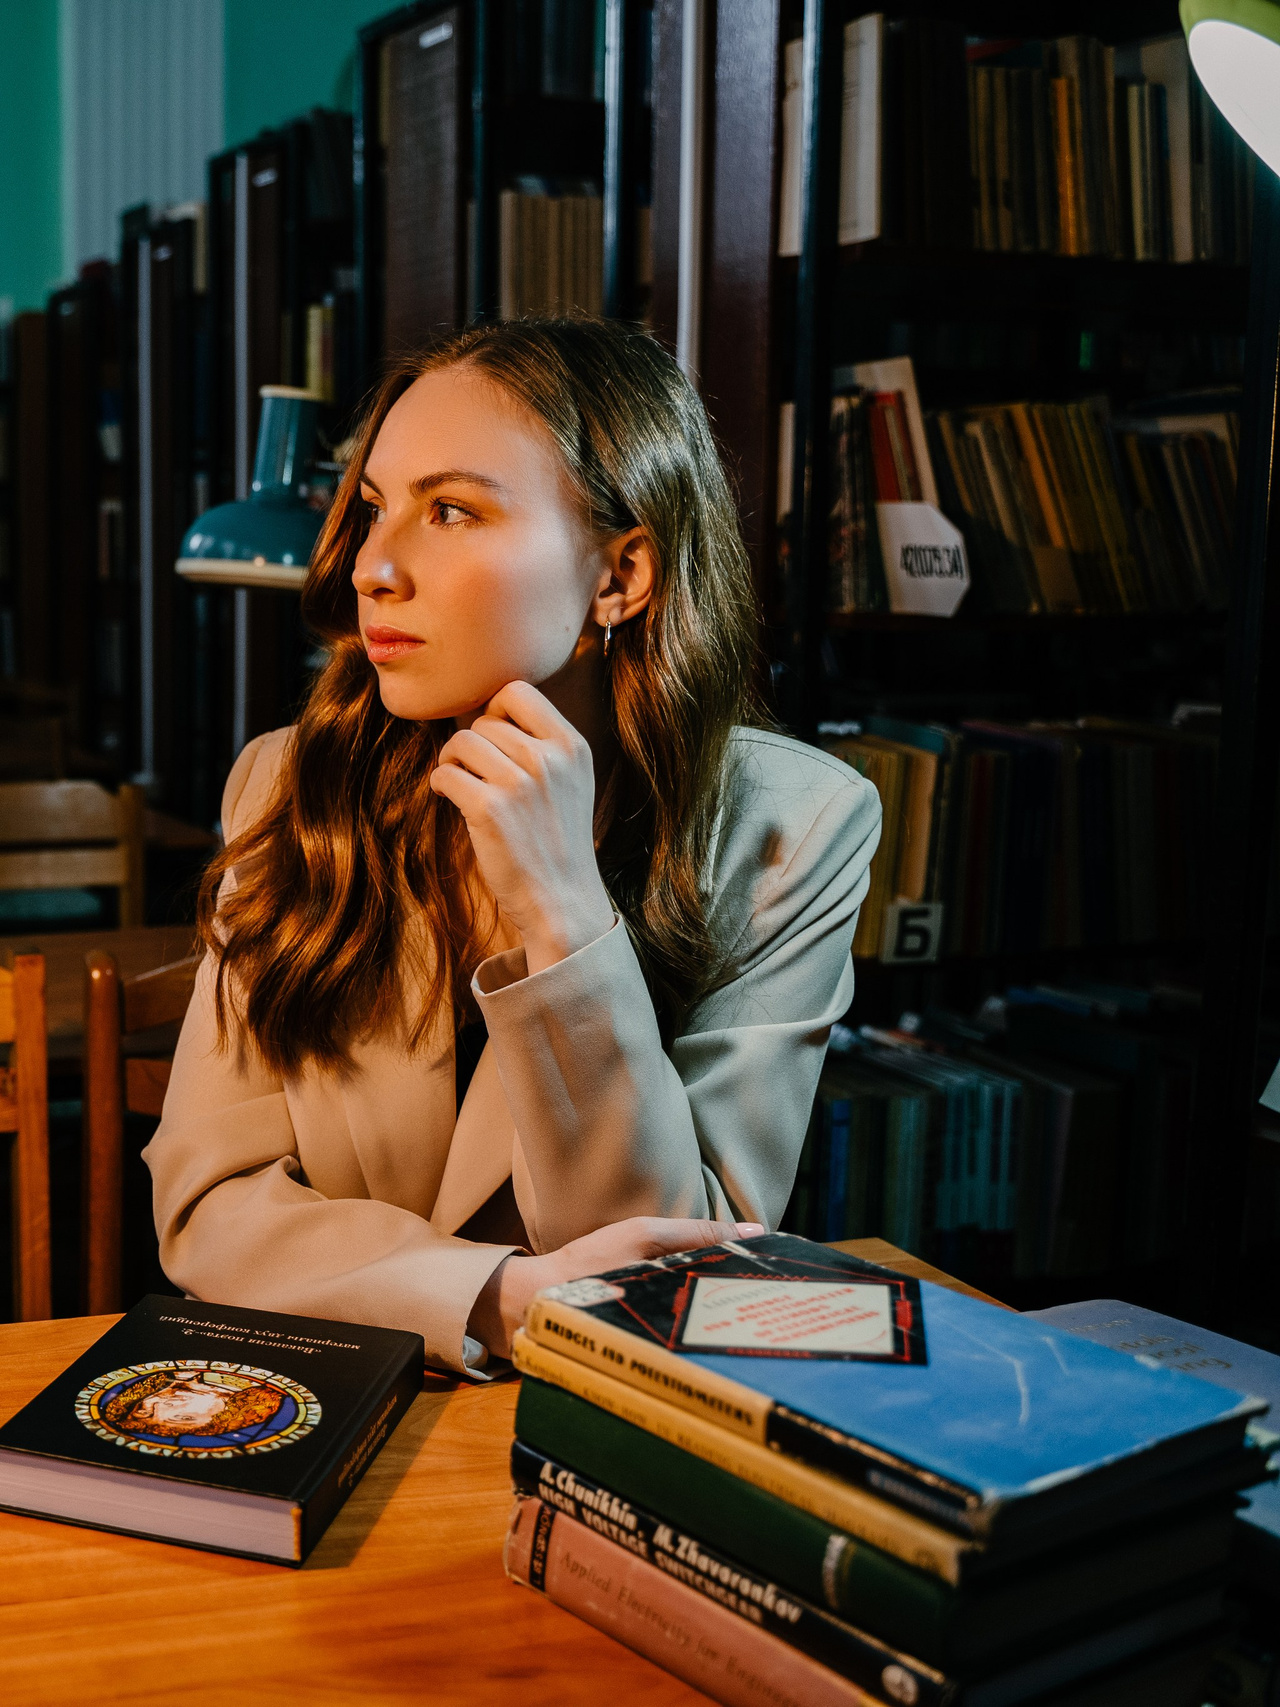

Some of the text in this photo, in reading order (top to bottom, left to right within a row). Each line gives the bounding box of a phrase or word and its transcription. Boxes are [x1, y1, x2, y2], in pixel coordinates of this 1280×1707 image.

[895, 907, 931, 958] Б
[159, 1315, 361, 1350] материалы двух конференций
[248, 1338, 322, 1354] «Вакансия
[544, 1318, 596, 1352] BRIDGES
[601, 1346, 625, 1366] AND
[630, 1358, 754, 1427] POTENTIOMETERS
[538, 1482, 576, 1517] HIGH
[582, 1506, 648, 1558] VOLTAGE
[561, 1551, 612, 1594] Applied
